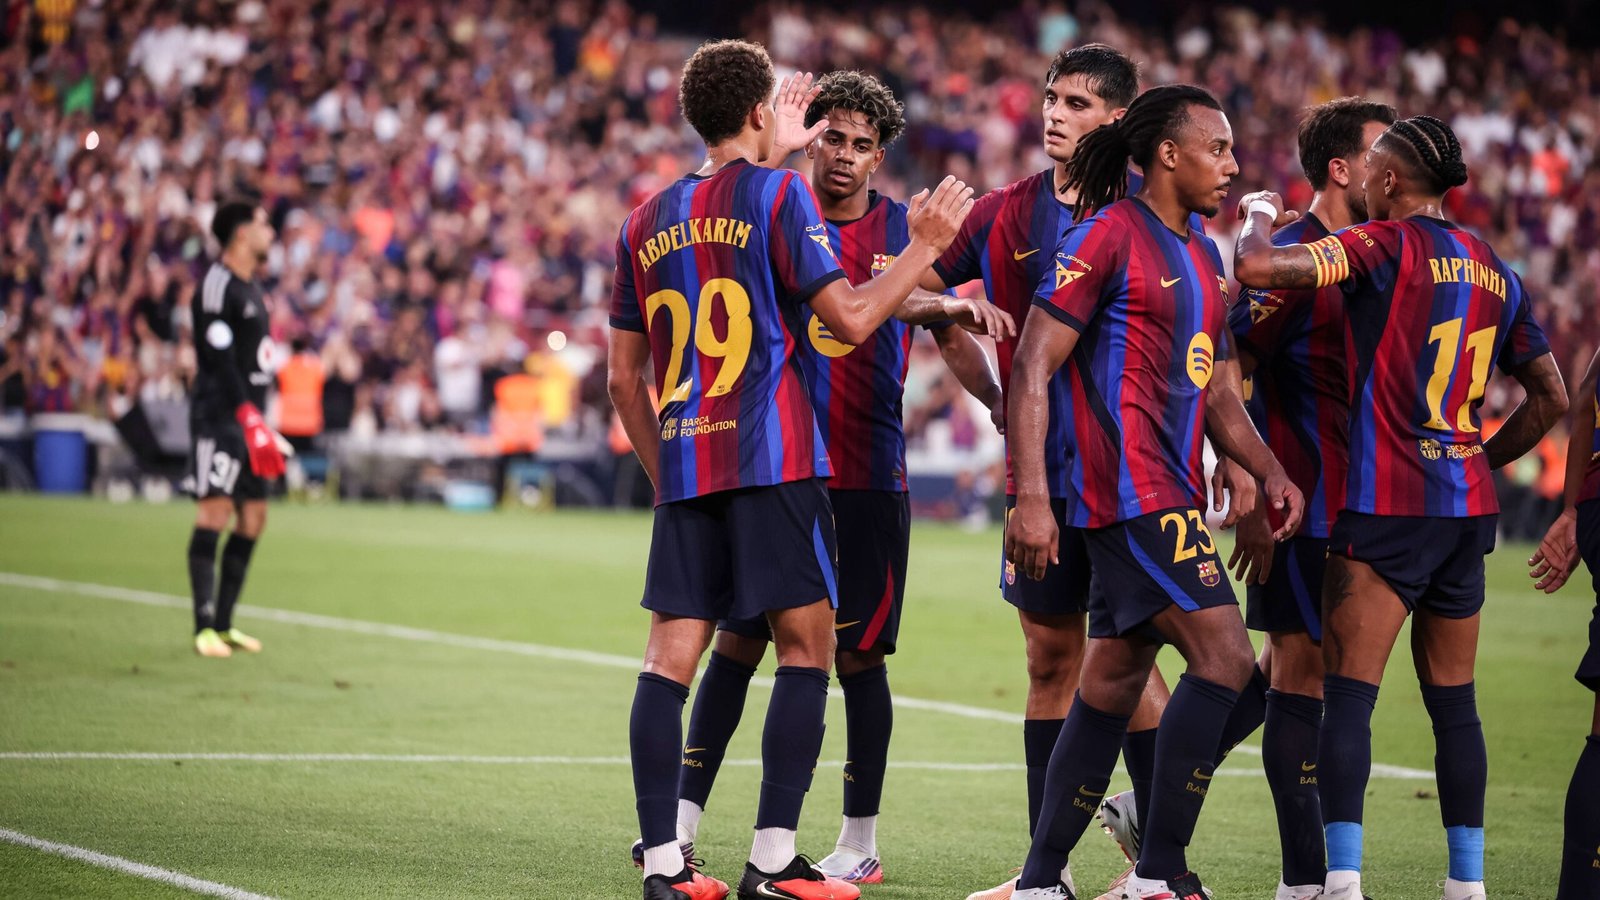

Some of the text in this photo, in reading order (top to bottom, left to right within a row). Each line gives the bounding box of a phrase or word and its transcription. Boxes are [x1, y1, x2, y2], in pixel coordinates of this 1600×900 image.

[638, 217, 753, 273] ABDELKARIM
[1056, 252, 1092, 271] CUPRA
[1428, 257, 1506, 303] RAPHINHA
[645, 278, 753, 411] 29
[1422, 317, 1497, 432] 11
[680, 420, 737, 437] FOUNDATION
[209, 451, 241, 495] 31
[1160, 510, 1216, 564] 23
